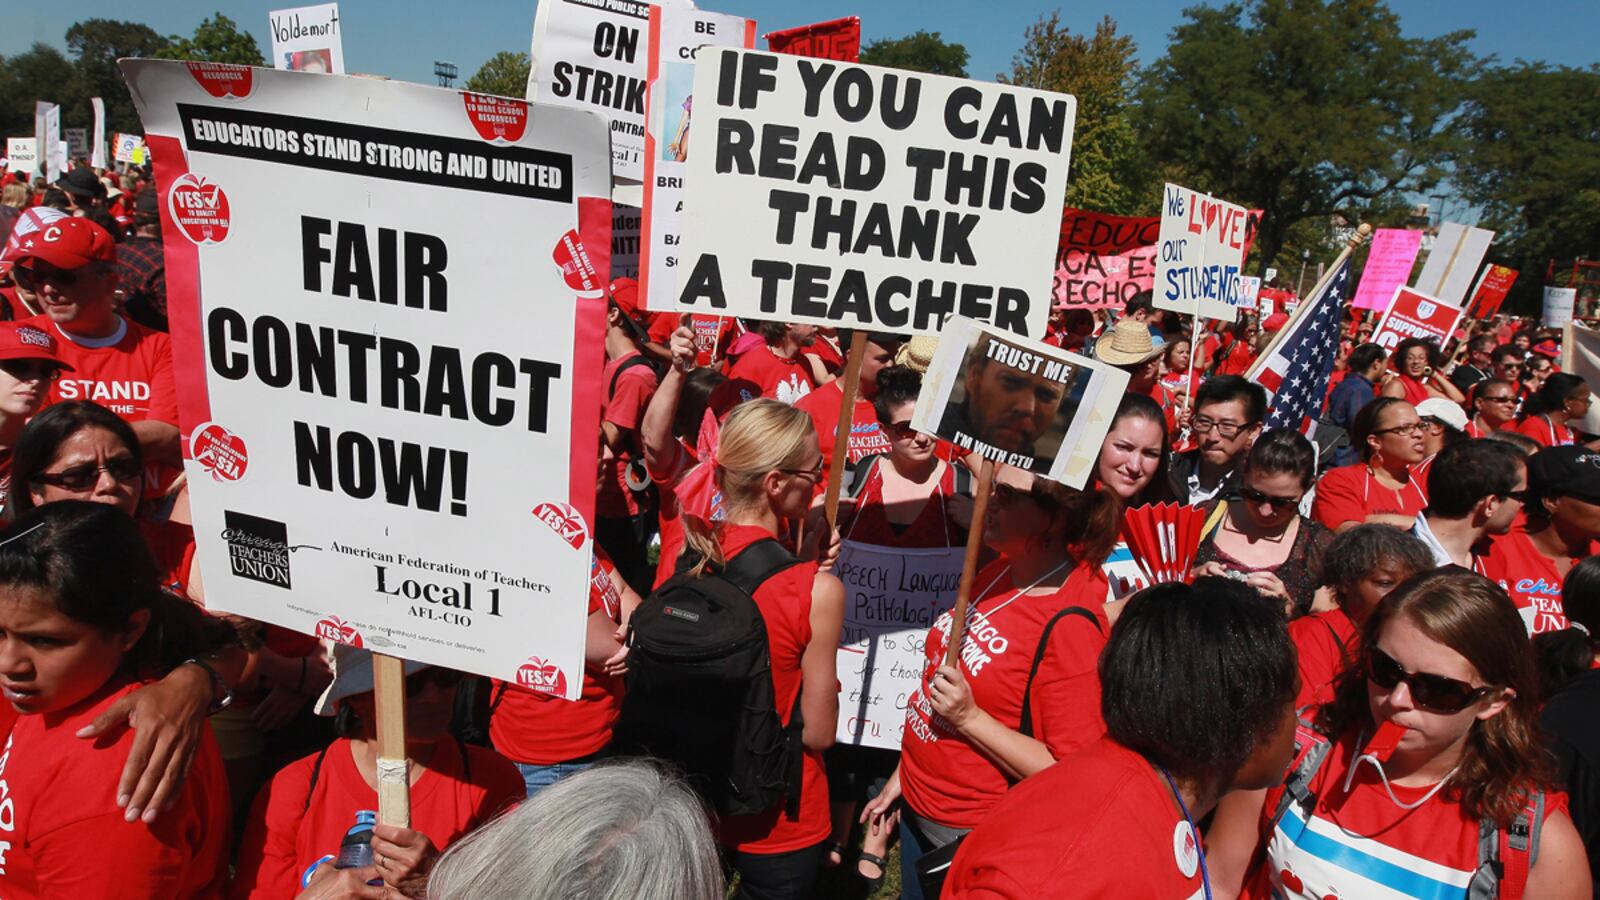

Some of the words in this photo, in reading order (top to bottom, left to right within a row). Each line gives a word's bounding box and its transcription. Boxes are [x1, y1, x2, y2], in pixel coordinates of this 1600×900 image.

[606, 0, 637, 14] PUBLIC
[272, 8, 338, 42] Voldemort
[695, 21, 716, 36] BE
[593, 22, 640, 64] ON
[552, 61, 647, 115] STRIK
[717, 50, 778, 110] IF
[797, 60, 922, 130] YOU
[944, 86, 1067, 154] CAN
[191, 118, 300, 154] EDUCATORS
[302, 132, 361, 162] STAND
[366, 142, 442, 173] STRONG
[446, 153, 487, 180] AND
[492, 158, 562, 190] UNITED
[634, 152, 638, 162] 1
[715, 118, 886, 192] READ
[906, 146, 1047, 214] THIS
[174, 192, 203, 208] YES
[1167, 187, 1184, 217] We
[44, 226, 61, 242] C
[768, 189, 980, 266] THANK
[301, 215, 448, 312] FAIR
[1162, 238, 1187, 262] our
[679, 252, 727, 308] A
[751, 258, 1030, 336] TEACHER
[1166, 265, 1240, 305] STUDENTS
[1386, 316, 1443, 340] SUPPOR
[208, 307, 562, 433] CONTRACT
[986, 339, 1043, 375] TRUST
[1043, 361, 1072, 384] ME
[58, 379, 150, 401] STAND
[110, 405, 134, 414] THE
[953, 431, 973, 450] I'M
[973, 439, 1006, 464] WITH
[1008, 452, 1034, 470] CTU
[216, 456, 240, 479] YES
[294, 420, 468, 517] NOW!
[538, 504, 564, 530] YES
[229, 544, 288, 568] TEACHERS
[231, 556, 288, 584] UNION
[330, 541, 394, 564] American
[398, 554, 471, 577] Federation
[474, 568, 488, 580] of
[490, 570, 551, 594] Teachers
[374, 564, 473, 611] Local
[487, 588, 504, 617] 1
[318, 622, 342, 640] YES
[407, 606, 472, 628] AFL-CIO
[884, 635, 896, 650] to
[959, 634, 993, 677] TRIKE
[519, 668, 543, 684] YES
[849, 689, 883, 705] that
